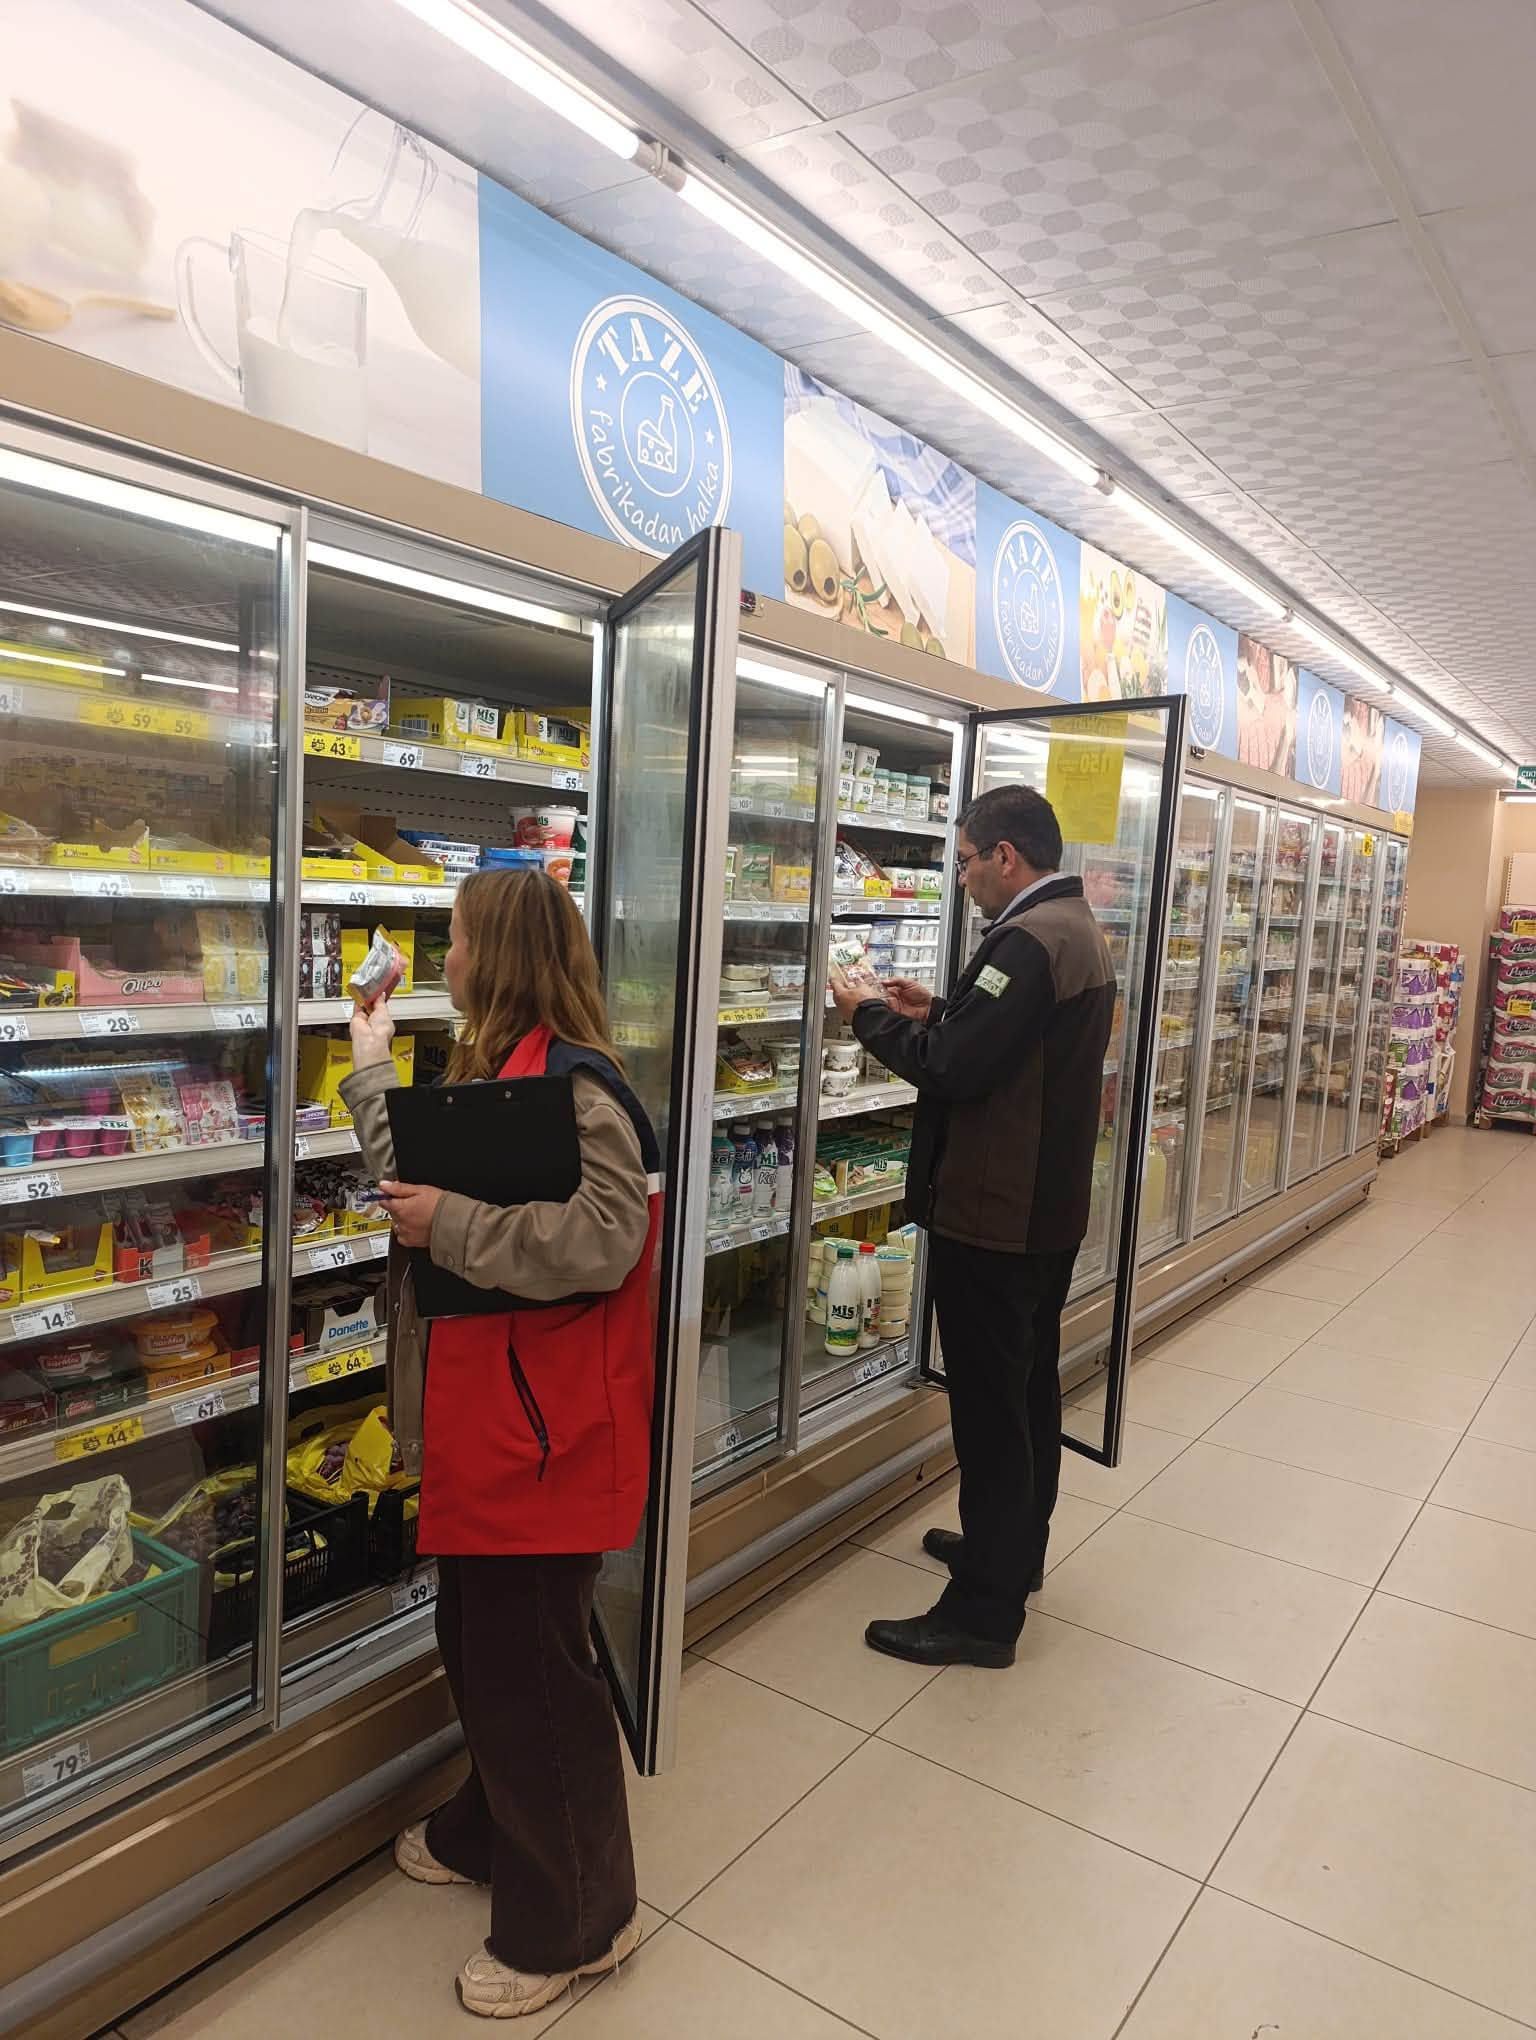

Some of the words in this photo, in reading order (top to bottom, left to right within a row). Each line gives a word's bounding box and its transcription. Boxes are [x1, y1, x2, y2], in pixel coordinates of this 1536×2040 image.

[596, 317, 711, 415] TAZE
[590, 409, 684, 544] fabrikadan
[686, 461, 719, 534] halka
[1004, 535, 1053, 592] TAZE
[330, 742, 346, 756] 43
[400, 752, 415, 766] 69
[476, 763, 489, 776] 22
[566, 777, 577, 789] 55
[349, 892, 366, 905] 49
[412, 894, 427, 906] 59
[107, 1018, 129, 1033] 28
[236, 1013, 255, 1027] 14
[761, 1152, 777, 1166] Mi
[28, 1182, 51, 1199] 52
[331, 1251, 345, 1265] 19
[172, 1286, 192, 1302] 25
[832, 1305, 854, 1317] Mis
[41, 1313, 64, 1330] 14
[328, 1320, 369, 1339] Danette
[347, 1357, 361, 1371] 64
[198, 1402, 214, 1419] 67
[106, 1431, 128, 1446] 44
[411, 1584, 428, 1603] 99
[53, 1754, 78, 1781] 79
